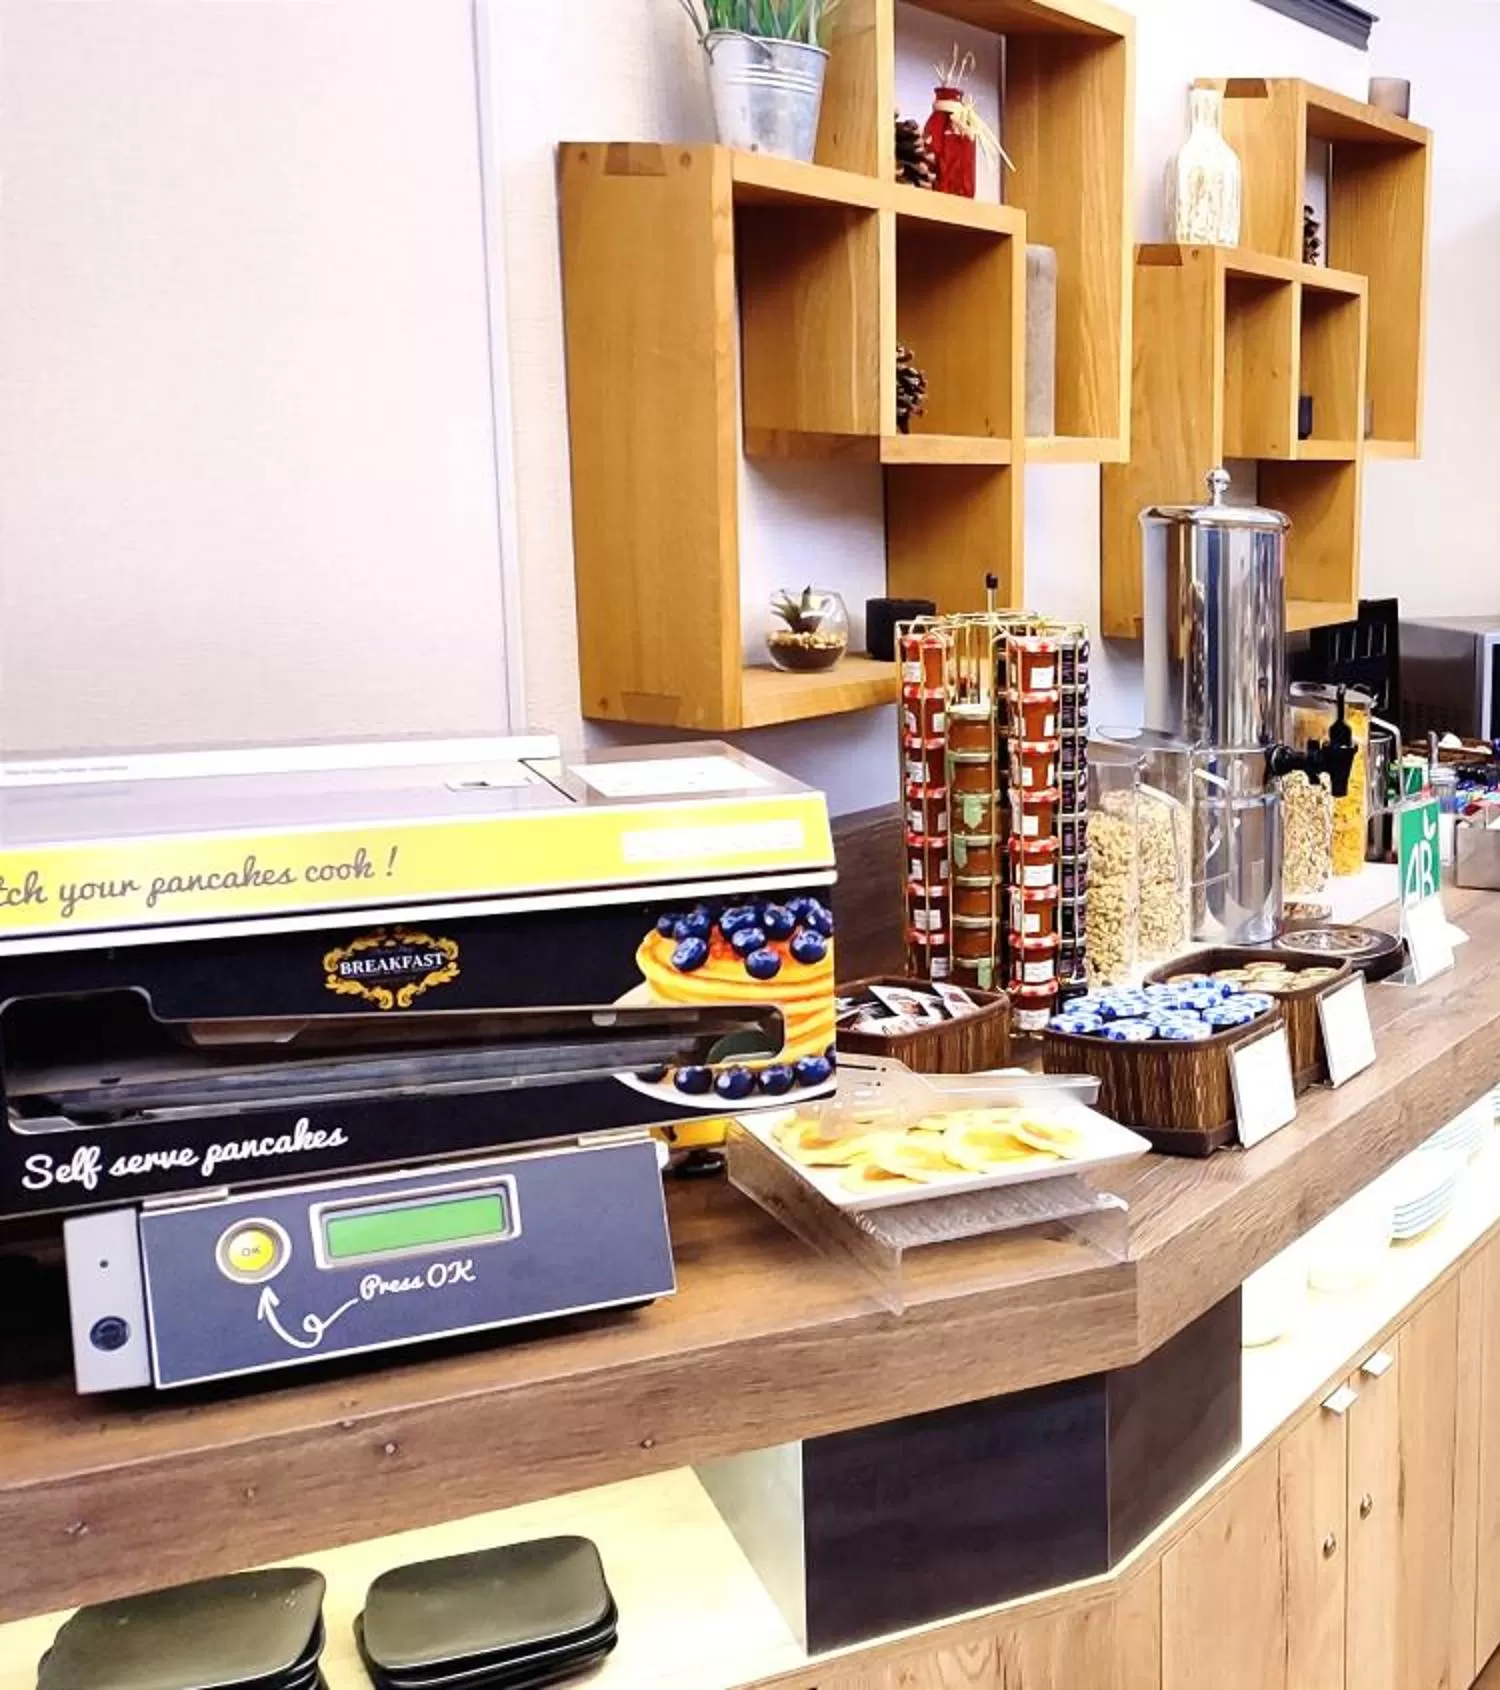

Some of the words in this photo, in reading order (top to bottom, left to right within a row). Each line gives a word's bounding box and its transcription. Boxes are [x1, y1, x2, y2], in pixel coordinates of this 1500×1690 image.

[58, 879, 142, 919] your
[145, 855, 298, 908] pancakes
[304, 847, 376, 883] cook
[339, 952, 448, 976] BREAKFAST
[21, 1145, 103, 1191] Self
[108, 1147, 199, 1177] serve
[201, 1117, 349, 1177] pancakes
[359, 1273, 424, 1300] Press
[426, 1258, 477, 1287] OK
